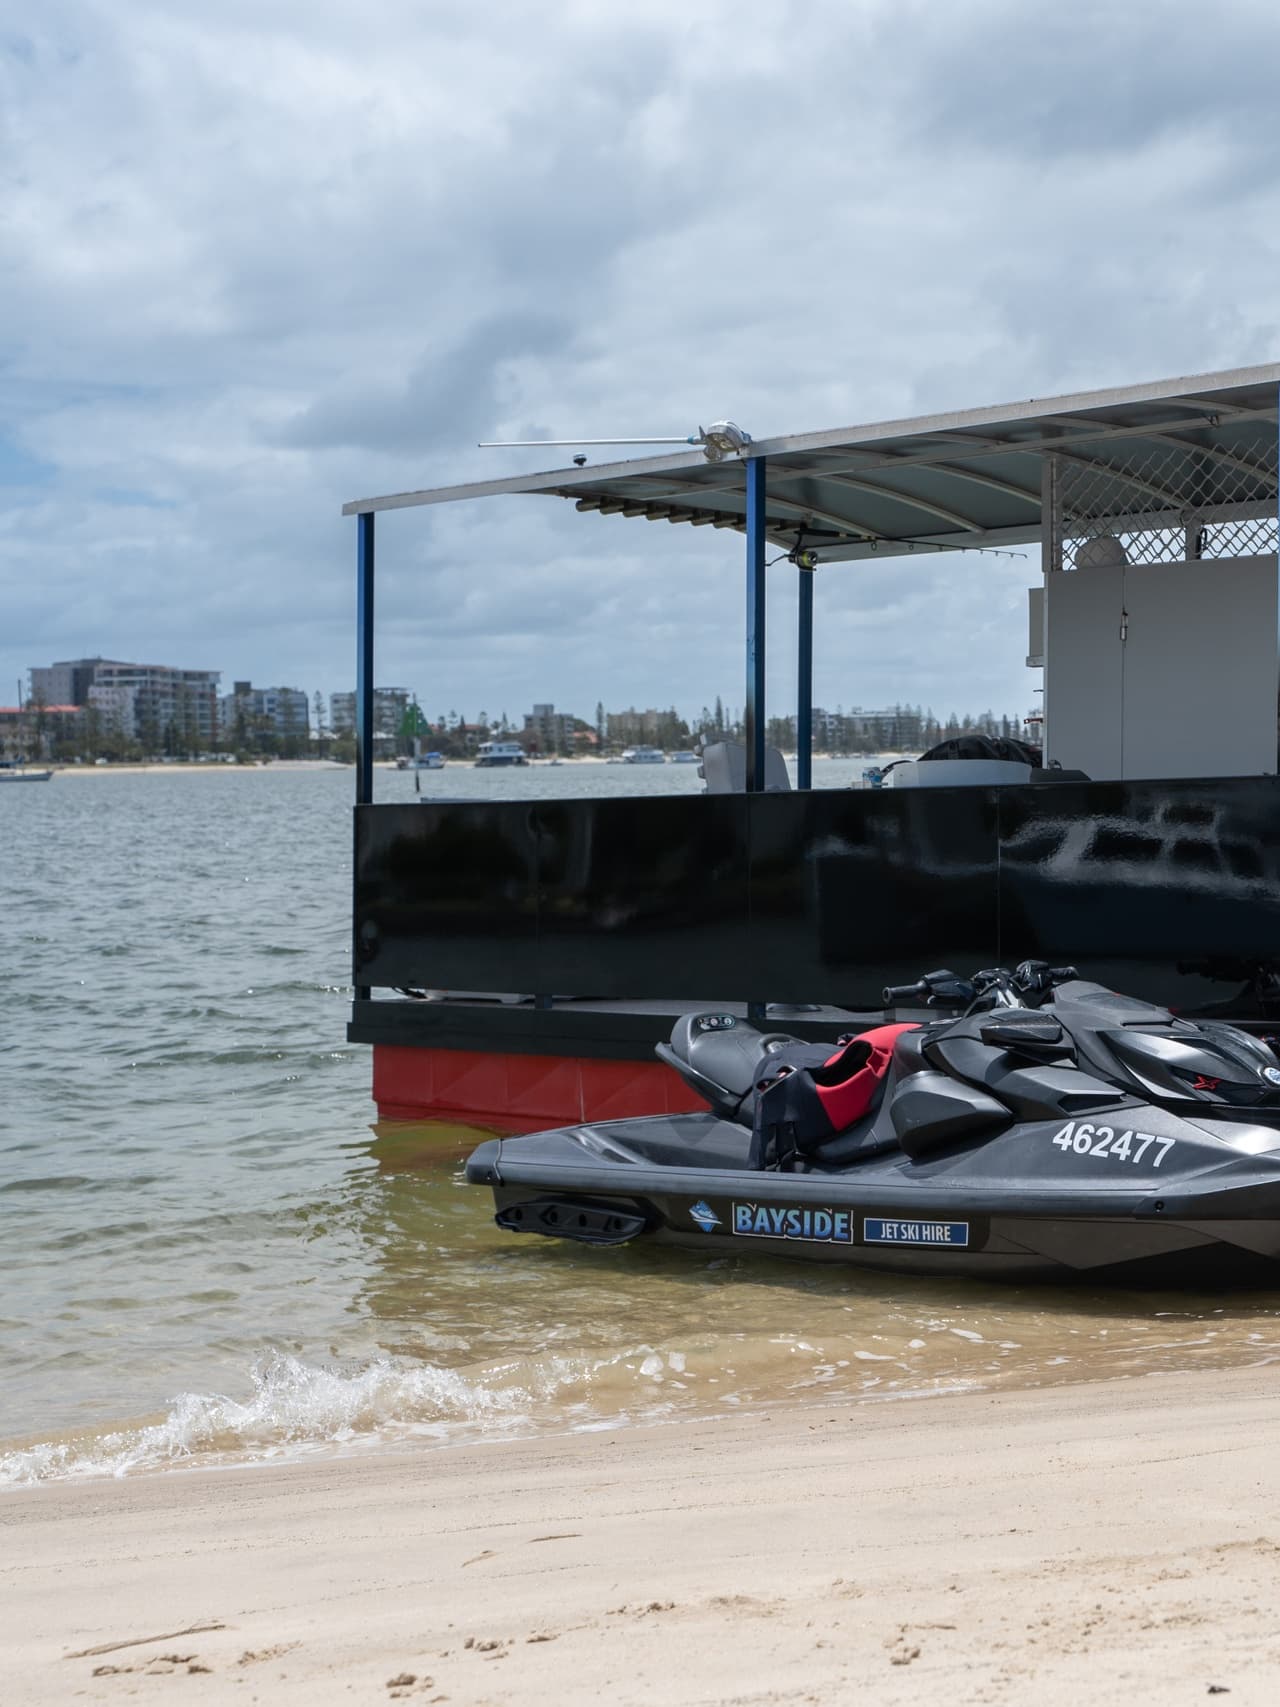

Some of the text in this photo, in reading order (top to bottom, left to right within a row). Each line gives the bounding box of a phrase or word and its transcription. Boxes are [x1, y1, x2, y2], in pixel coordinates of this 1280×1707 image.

[1052, 1121, 1177, 1168] 462477
[735, 1205, 850, 1240] BAYSIDE
[881, 1223, 951, 1242] JET SKI HIRE
